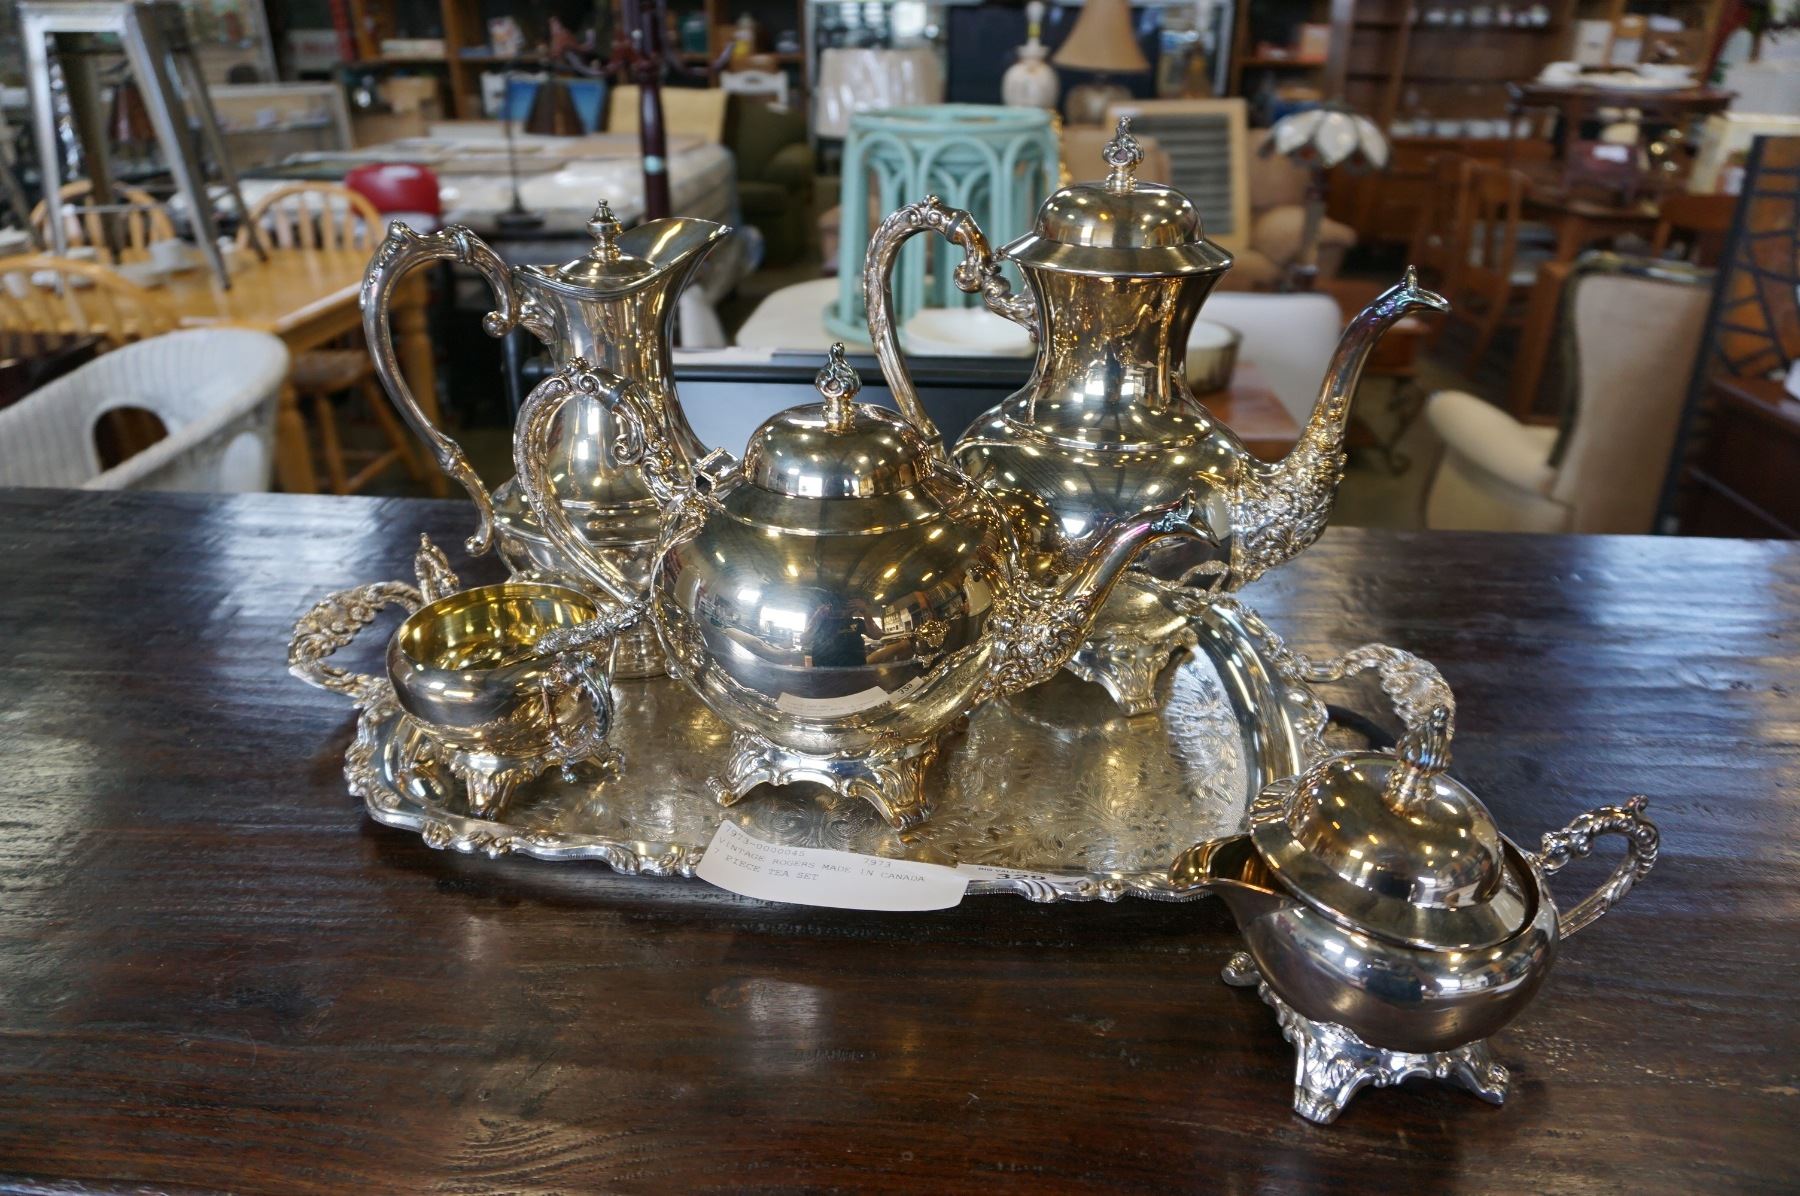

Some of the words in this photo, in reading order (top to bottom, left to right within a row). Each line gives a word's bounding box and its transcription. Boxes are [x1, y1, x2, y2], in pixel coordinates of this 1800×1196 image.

[719, 837, 765, 862] VINTAGE
[772, 858, 816, 868] ROGERS
[822, 864, 851, 873] MADE
[860, 868, 874, 876] IN
[881, 872, 925, 882] CANADA
[726, 854, 761, 873] PIECE
[768, 868, 789, 876] TEA
[796, 873, 820, 881] SET
[863, 857, 891, 868] 7973
